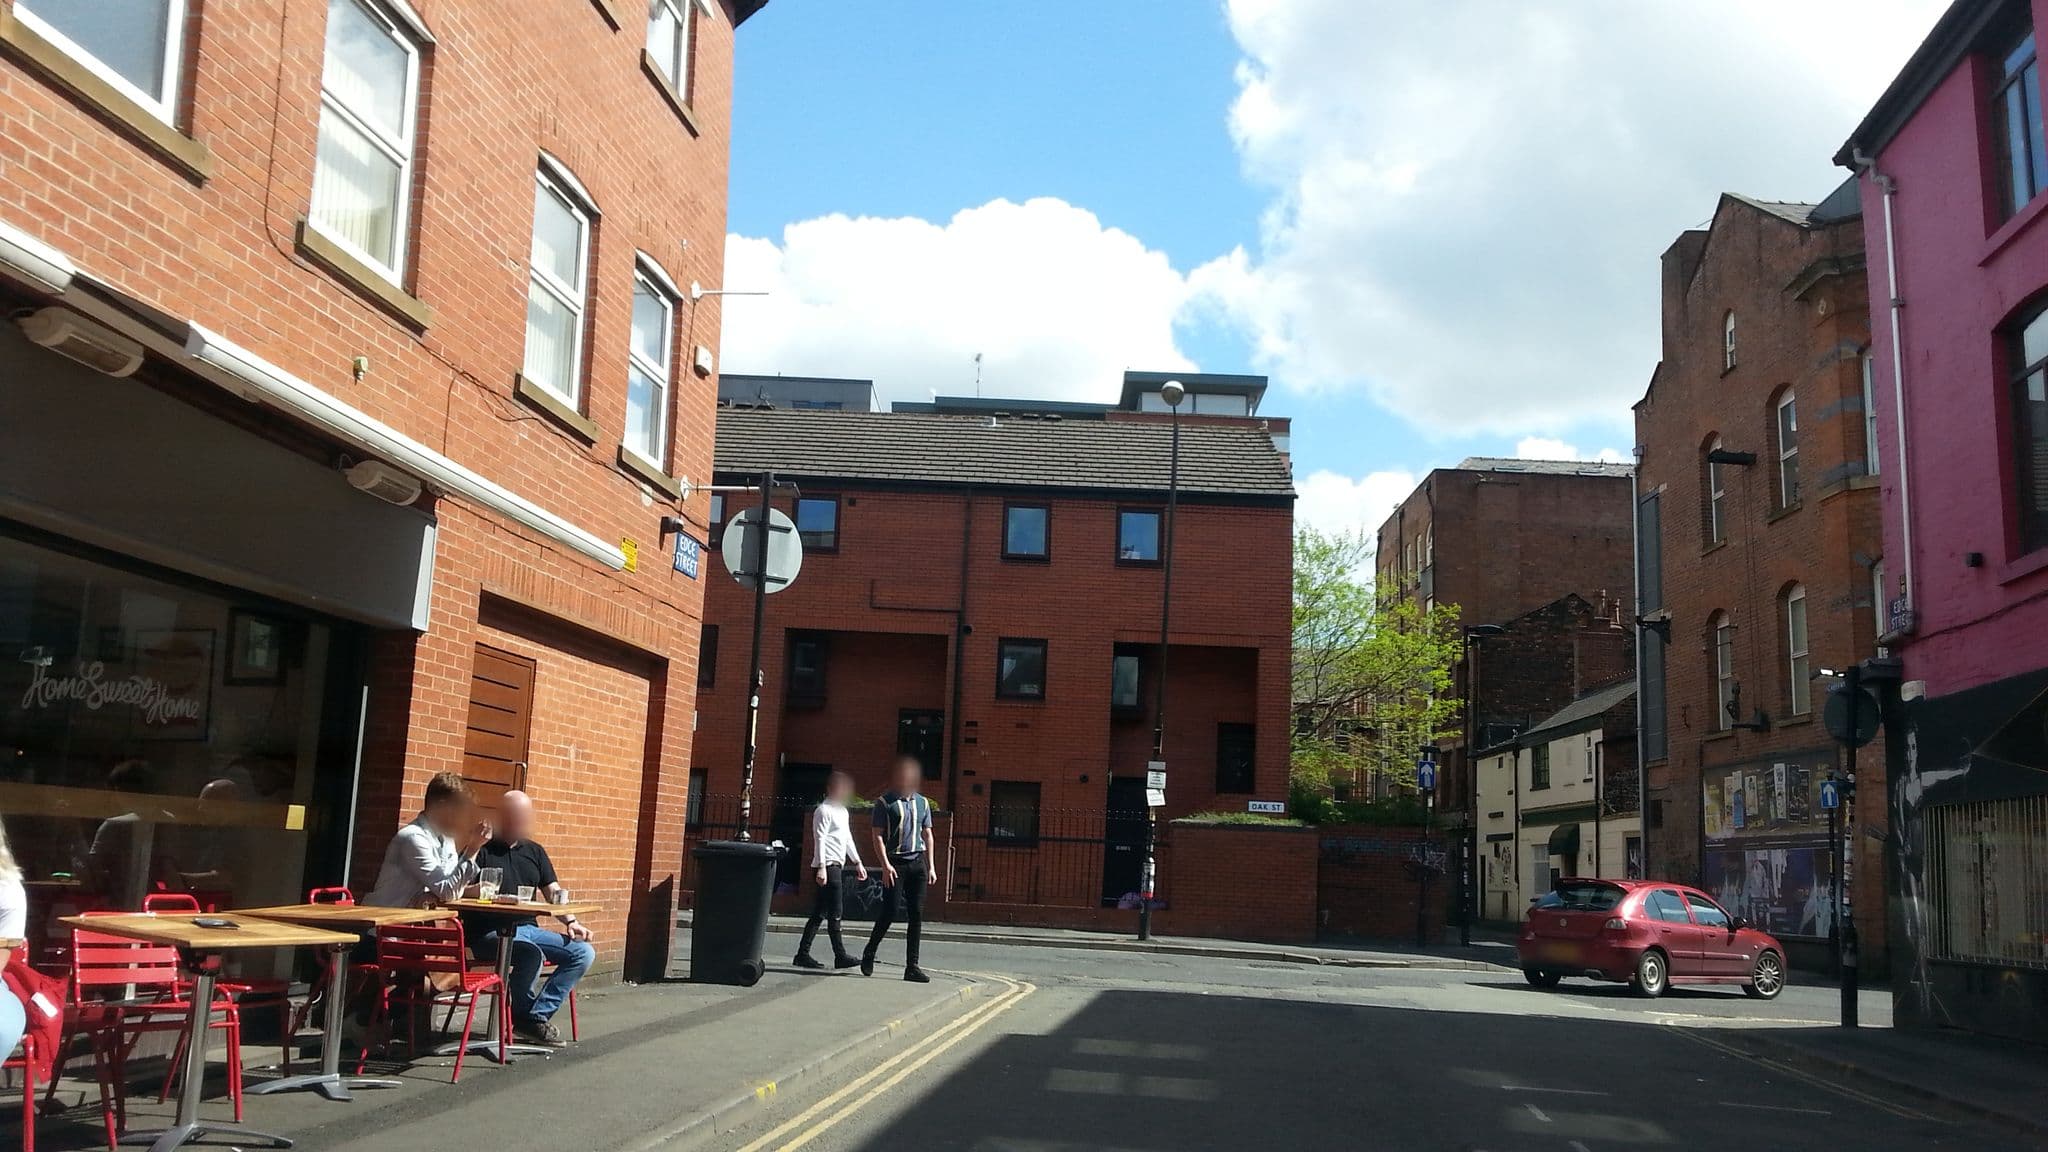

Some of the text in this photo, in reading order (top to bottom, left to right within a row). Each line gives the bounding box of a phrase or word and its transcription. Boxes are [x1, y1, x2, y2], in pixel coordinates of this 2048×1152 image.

[680, 535, 697, 557] EDGE
[675, 551, 698, 576] STREET
[21, 661, 200, 725] Home Sweet Home
[1251, 803, 1281, 812] OAK ST
